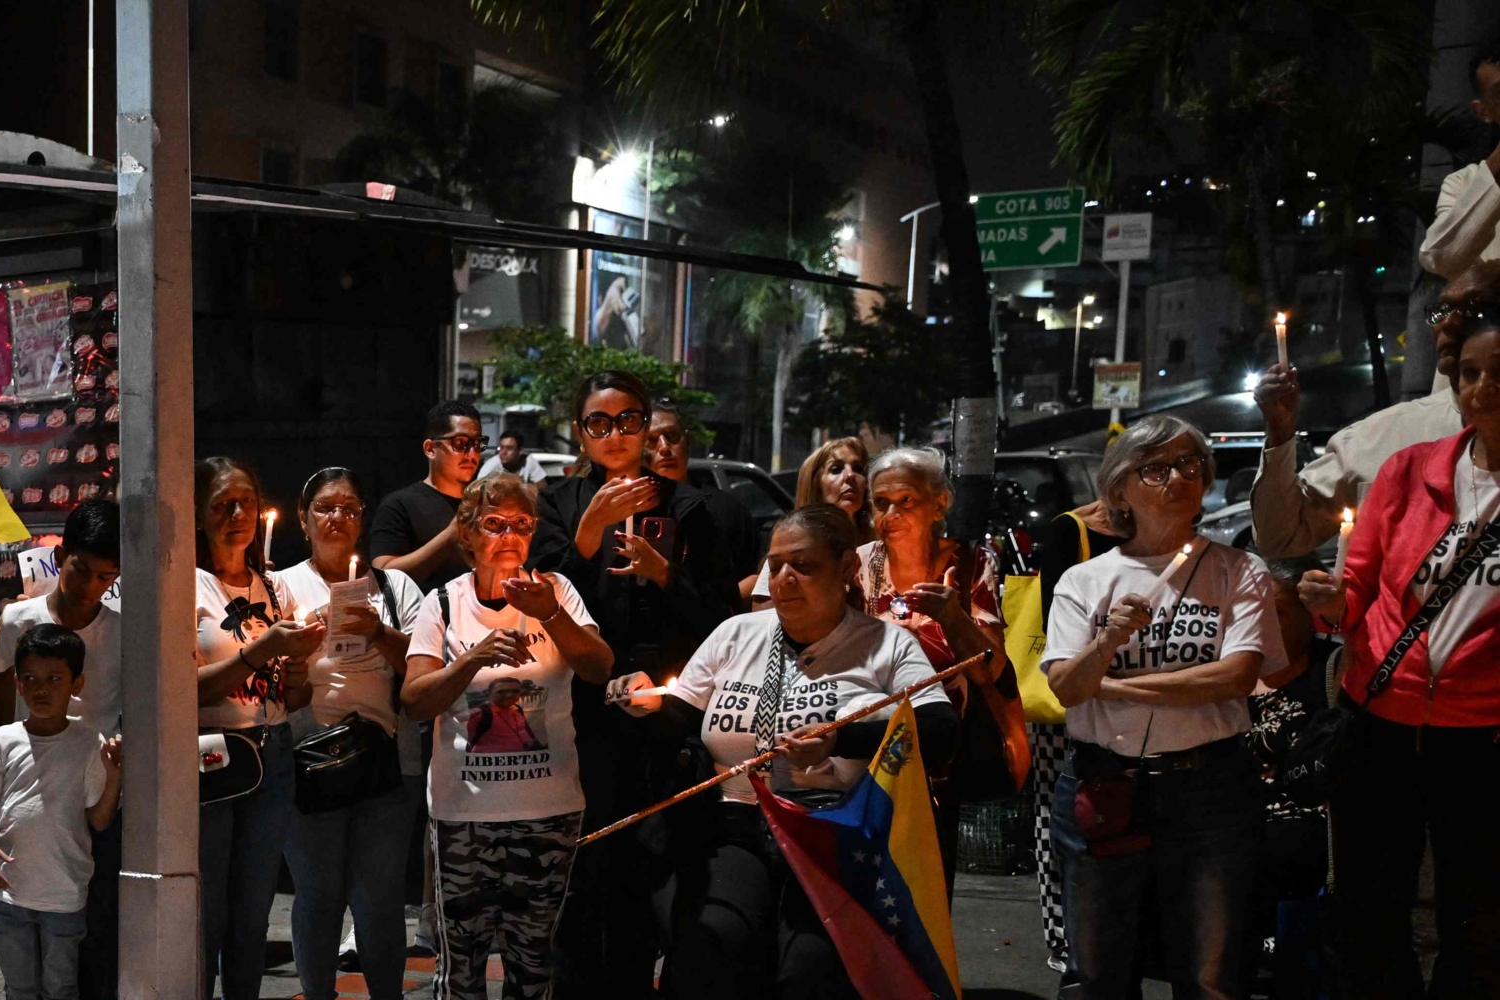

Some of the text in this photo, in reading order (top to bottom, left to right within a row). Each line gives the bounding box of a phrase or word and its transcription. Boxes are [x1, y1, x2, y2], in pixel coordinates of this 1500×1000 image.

[995, 196, 1071, 214] COTA 905
[1426, 532, 1498, 609] NAUTICA
[1157, 603, 1219, 618] A TODOS
[1139, 618, 1218, 643] PRESOS
[1368, 614, 1429, 692] NAUTICA
[268, 663, 280, 700] LOVE
[791, 680, 838, 696] TODOS
[715, 694, 749, 711] LOS
[465, 753, 550, 767] LIBERTAD
[461, 767, 552, 782] INMEDIATA
